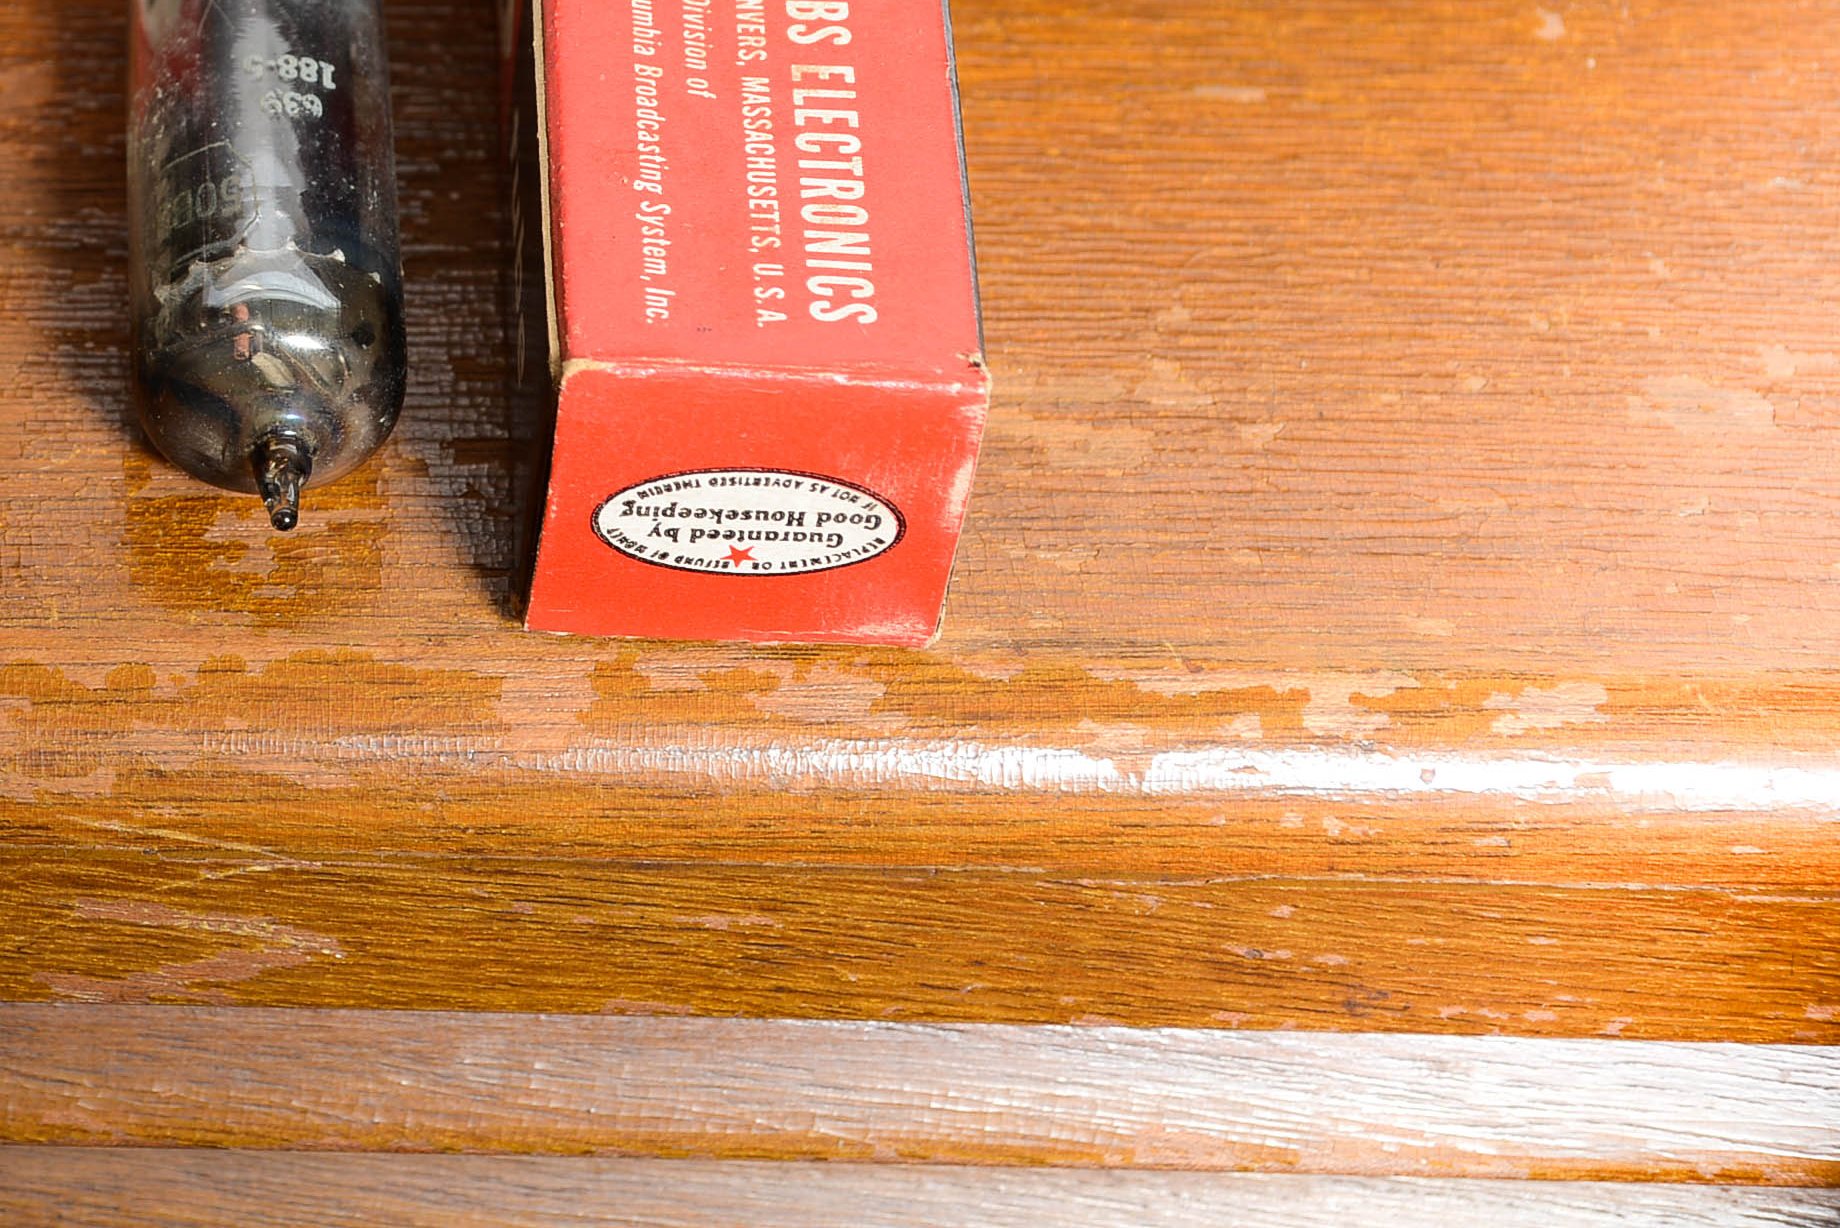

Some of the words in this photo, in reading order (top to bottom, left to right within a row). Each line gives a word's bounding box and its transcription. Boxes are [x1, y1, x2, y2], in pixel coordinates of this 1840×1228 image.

[685, 77, 718, 100] of
[632, 63, 670, 196] Broadcasting
[740, 76, 782, 253] MASSACHUSETTS,
[790, 63, 878, 325] ELECTRONICS
[634, 200, 673, 282] System,
[644, 285, 677, 325] Inc.
[619, 499, 806, 527] Housekeeping
[816, 511, 882, 531] Good
[648, 522, 680, 543] by
[690, 525, 844, 548] Guaranteed
